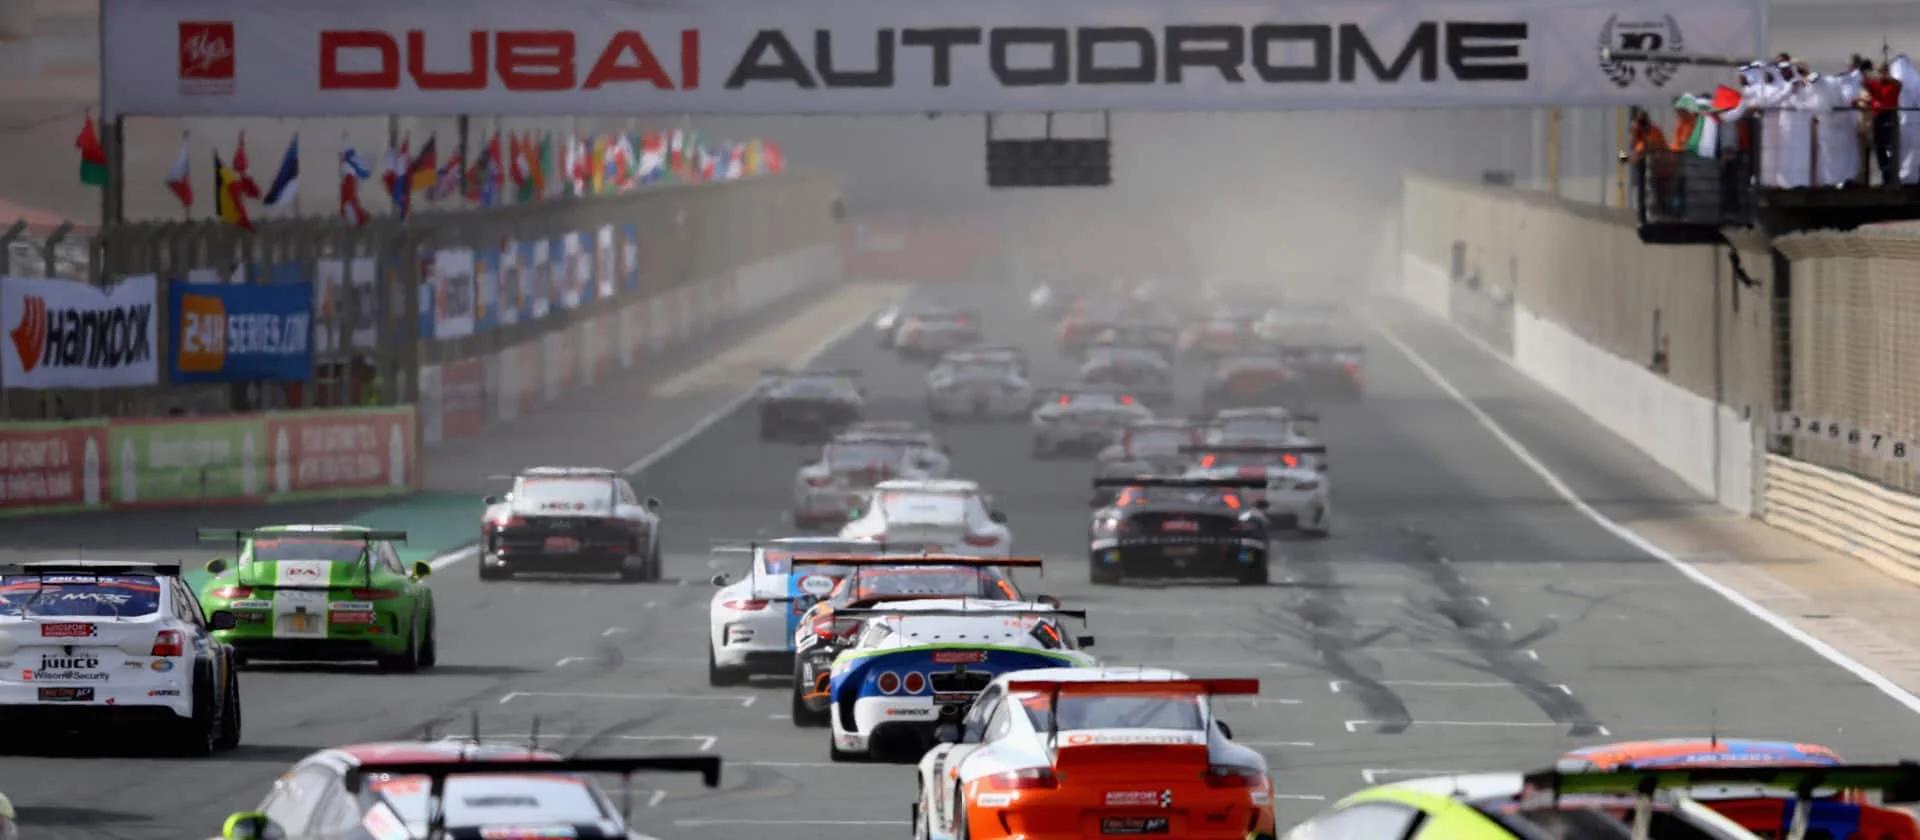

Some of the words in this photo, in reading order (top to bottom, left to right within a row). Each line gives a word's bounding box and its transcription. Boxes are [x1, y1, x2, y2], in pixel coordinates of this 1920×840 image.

[318, 29, 700, 91] DUBAI
[725, 22, 1529, 90] AUTODROME
[38, 653, 99, 672] juuce
